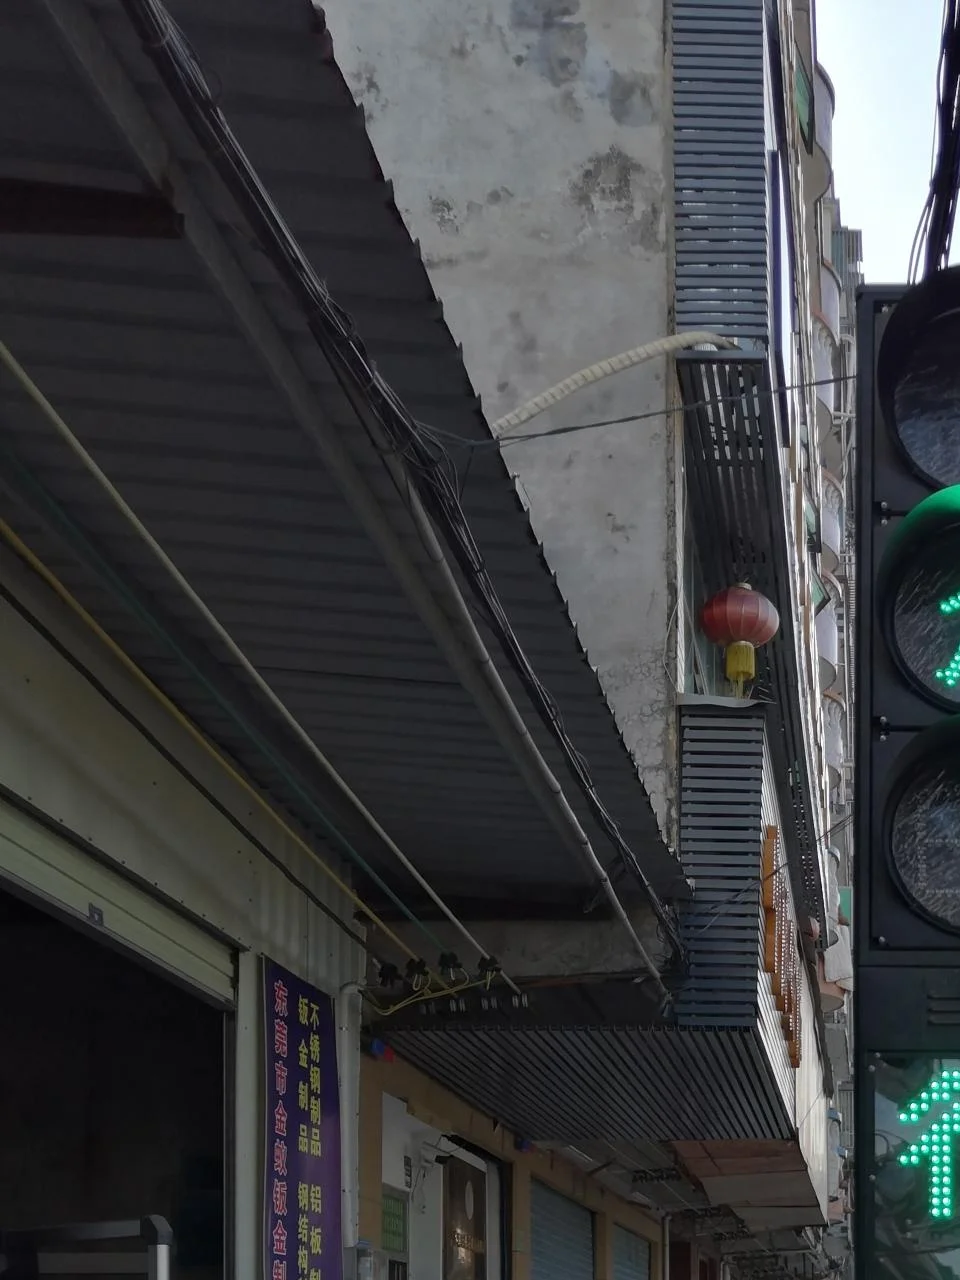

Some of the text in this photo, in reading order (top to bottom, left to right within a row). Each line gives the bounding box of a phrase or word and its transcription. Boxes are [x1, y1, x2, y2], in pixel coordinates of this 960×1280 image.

[310, 1002, 321, 1157] 不锈钢制品
